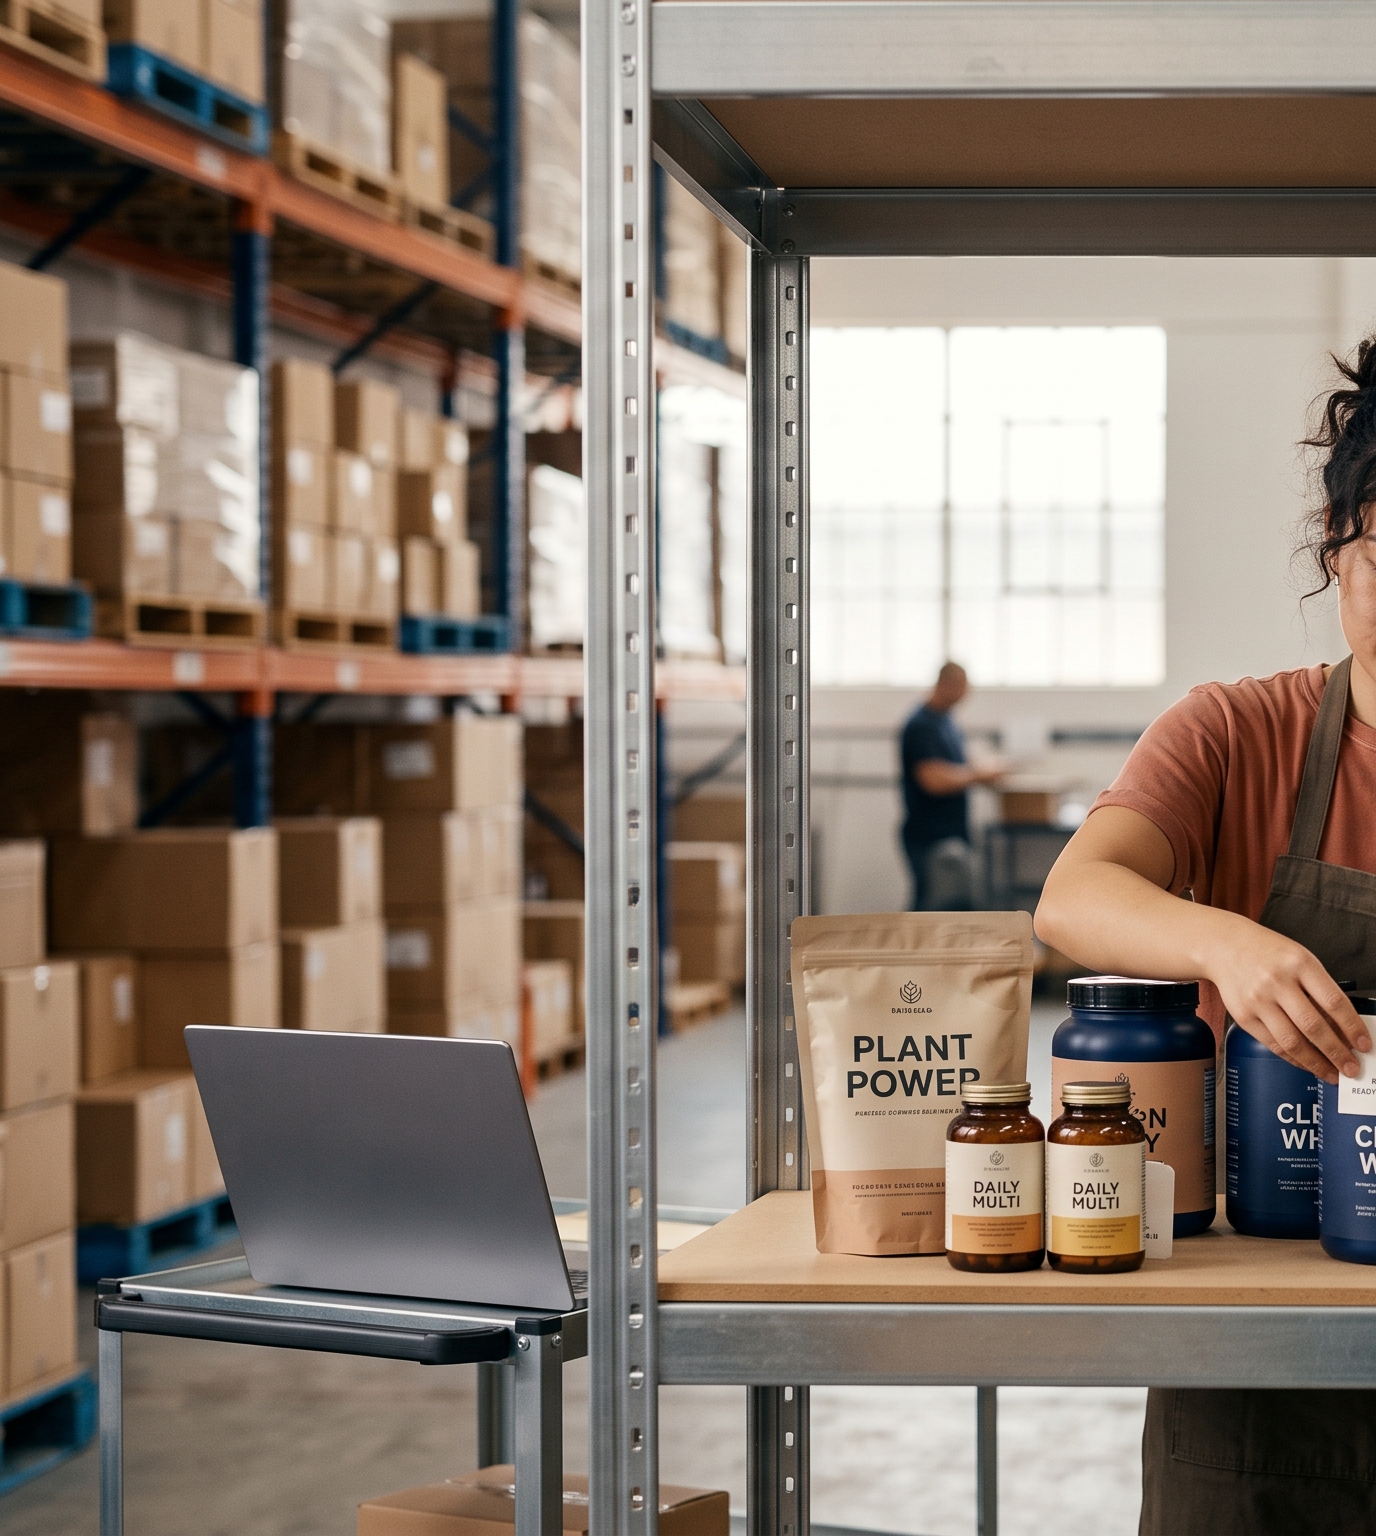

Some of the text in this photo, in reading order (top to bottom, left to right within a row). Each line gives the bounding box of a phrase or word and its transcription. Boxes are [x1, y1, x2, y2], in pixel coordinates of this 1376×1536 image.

[853, 1033, 973, 1063] PLANT
[1351, 1087, 1376, 1095] READY
[973, 1180, 1021, 1194] DAILY
[1072, 1182, 1120, 1195] DAILY
[972, 1195, 1021, 1209] MULTI
[1071, 1196, 1120, 1210] MULTI
